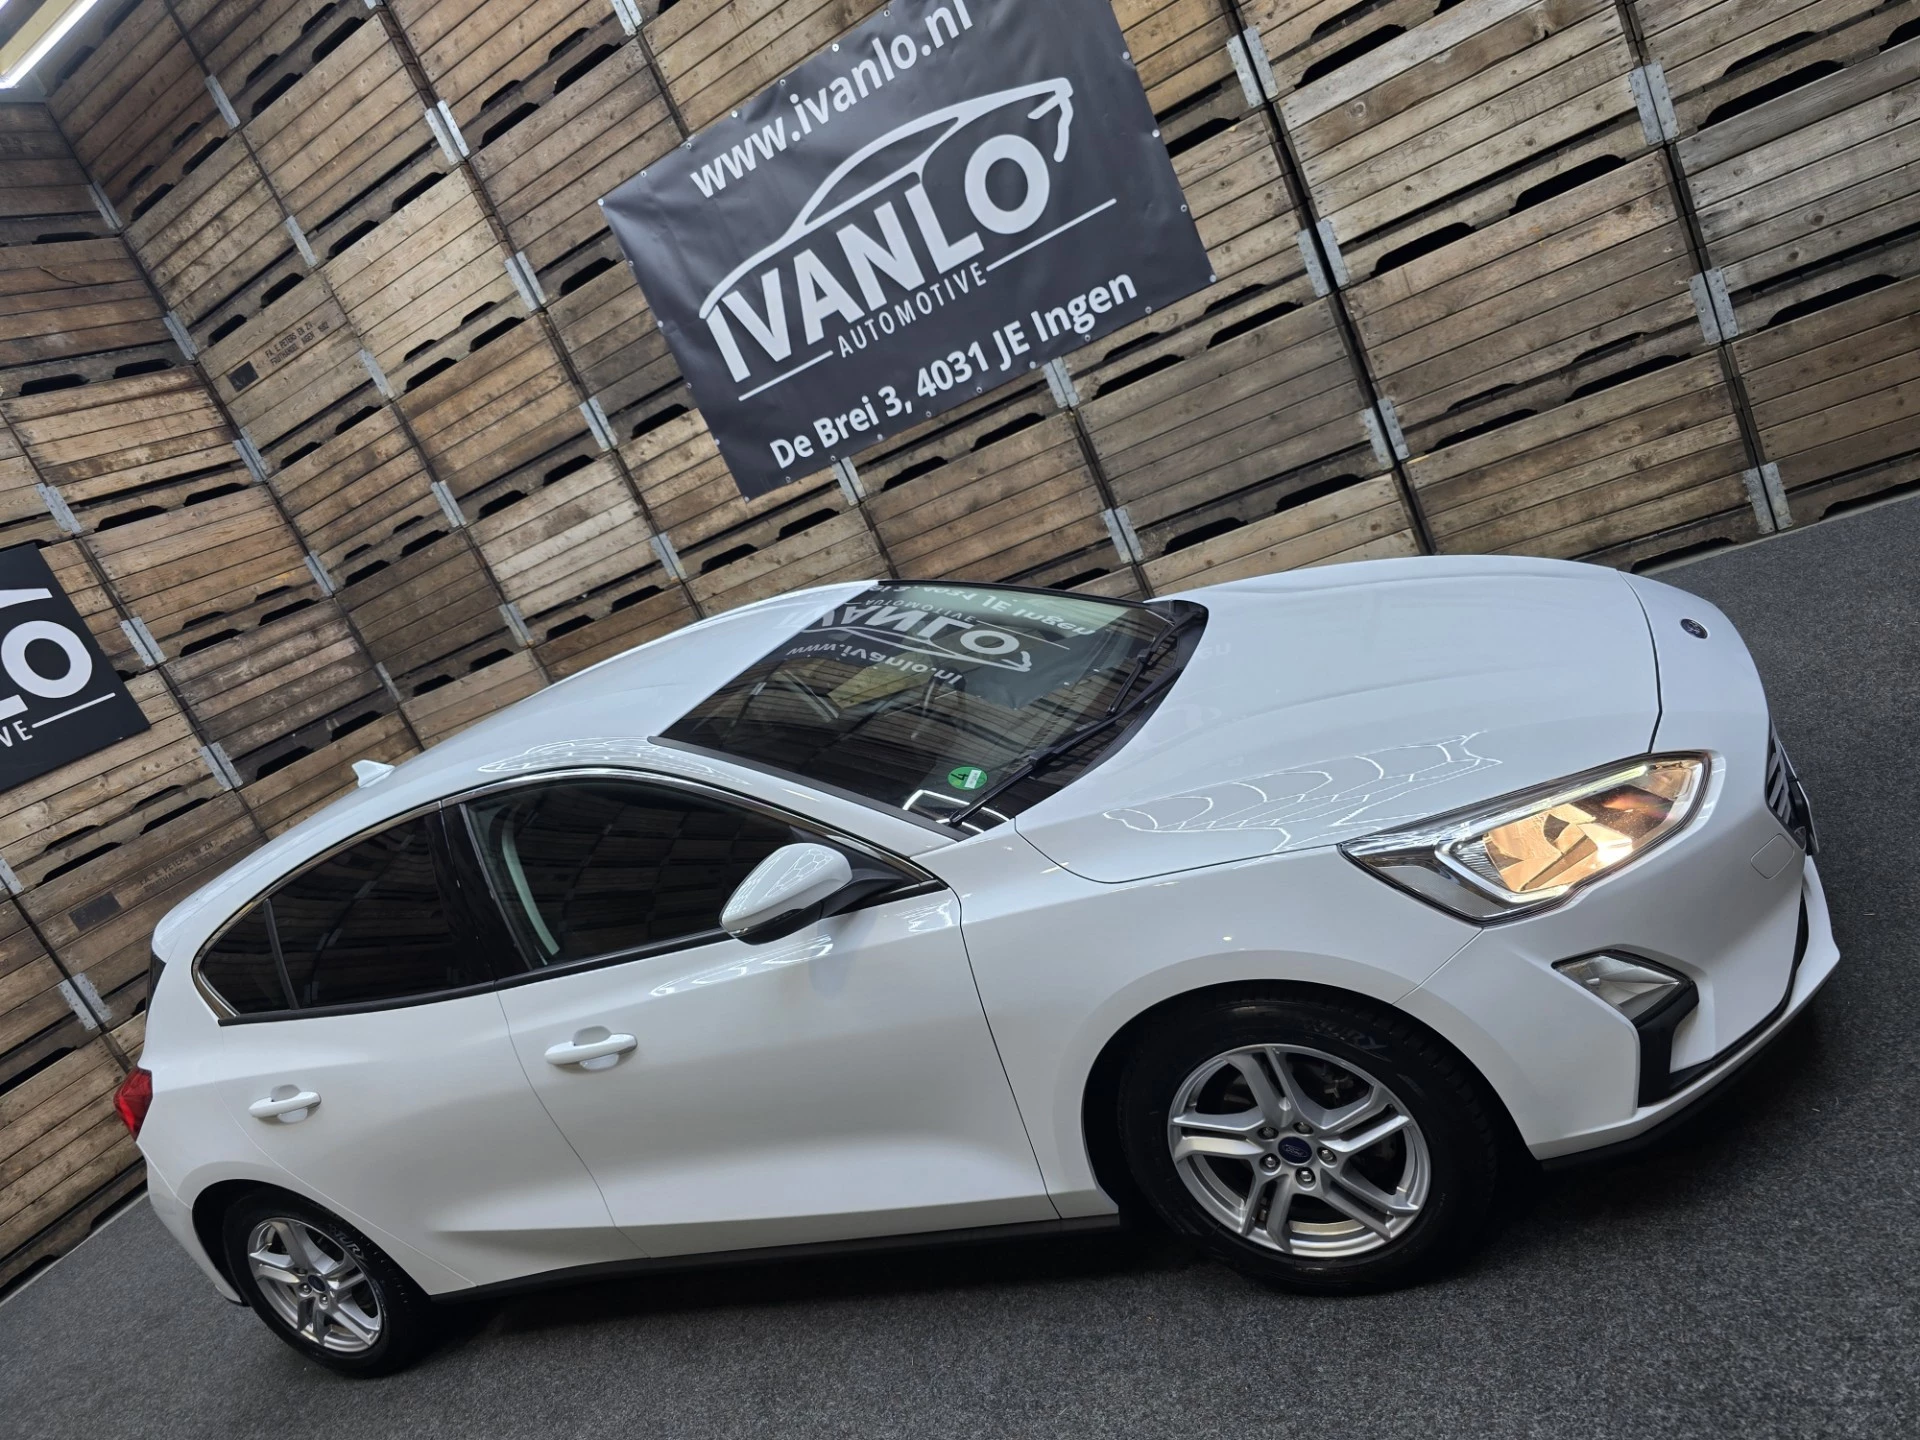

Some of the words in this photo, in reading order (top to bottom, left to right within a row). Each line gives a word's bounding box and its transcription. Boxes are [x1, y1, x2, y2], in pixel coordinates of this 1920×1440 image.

[690, 0, 974, 198] www.ivanlo.nl
[703, 133, 1050, 383] IVANLO
[838, 262, 987, 358] AUTOMOTIVE
[769, 438, 814, 470] De
[813, 395, 880, 448] Brei
[878, 385, 913, 417] 3,
[917, 341, 989, 397] 4031
[992, 320, 1030, 372] JE
[1031, 273, 1137, 342] Ingen
